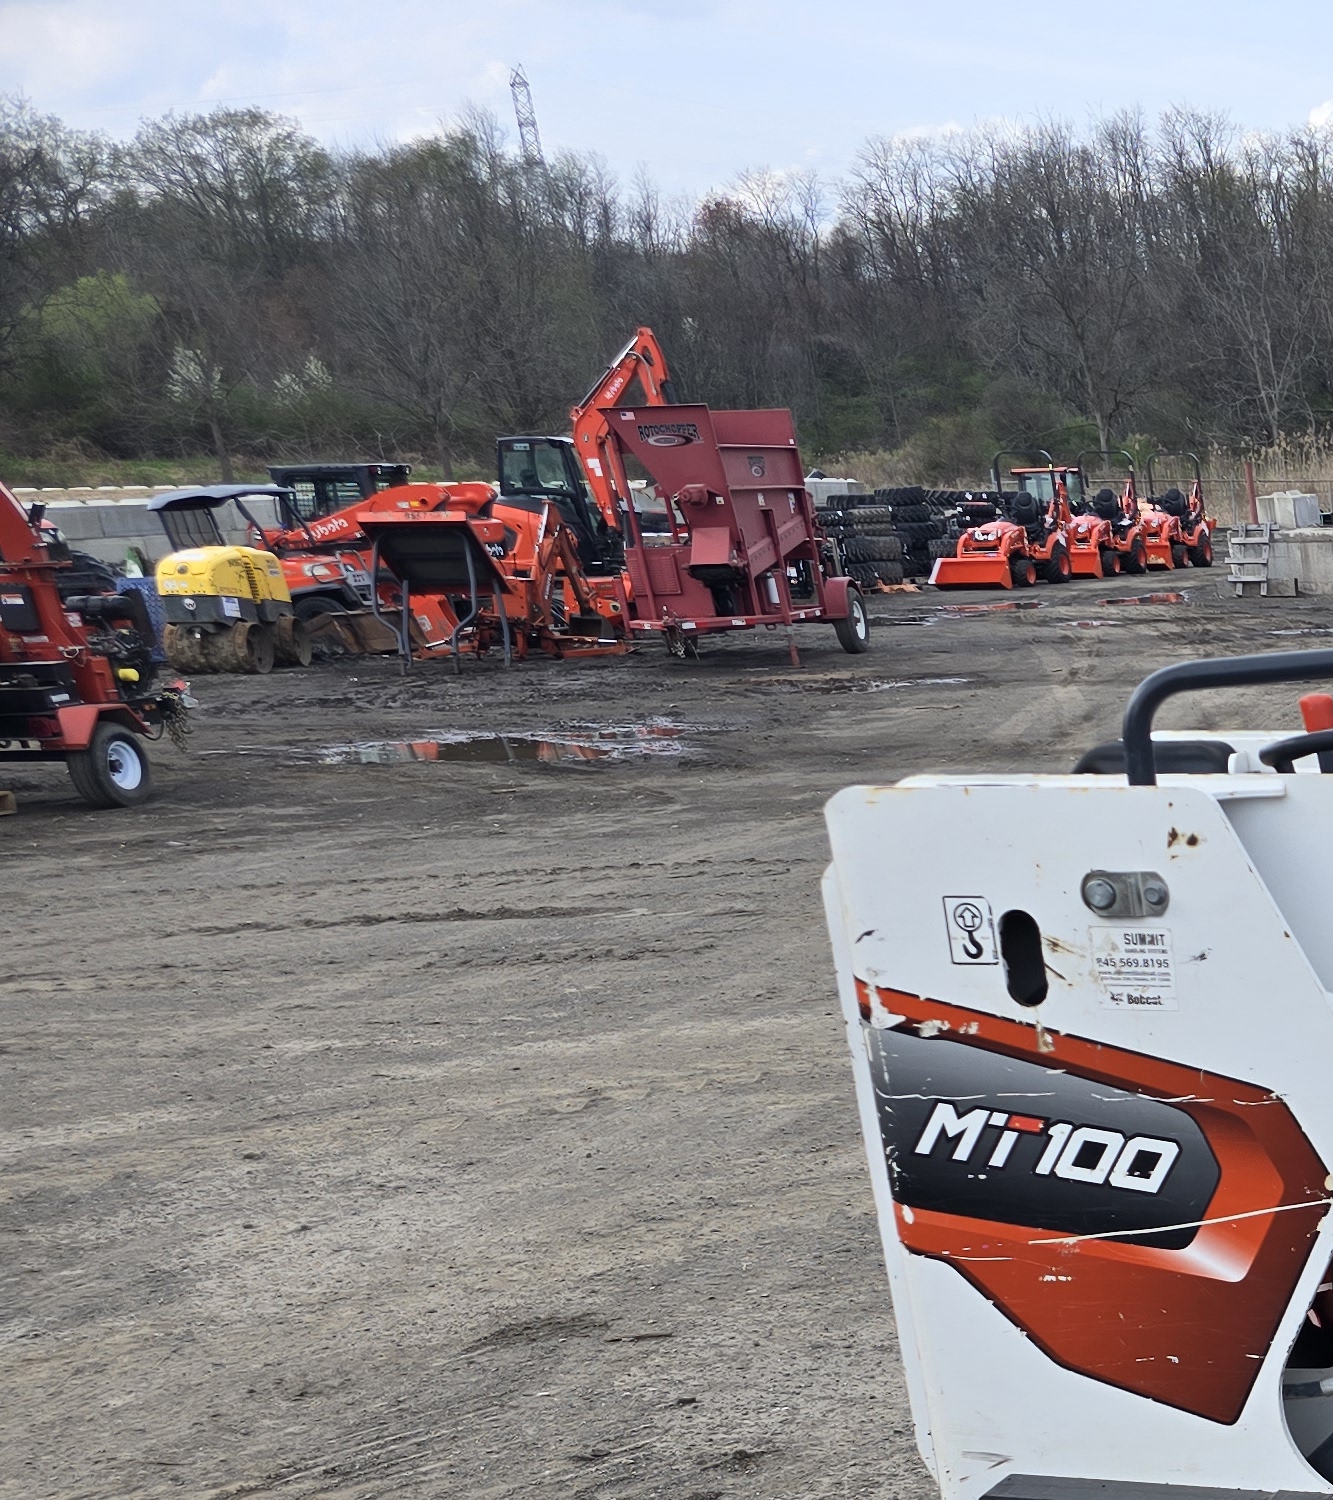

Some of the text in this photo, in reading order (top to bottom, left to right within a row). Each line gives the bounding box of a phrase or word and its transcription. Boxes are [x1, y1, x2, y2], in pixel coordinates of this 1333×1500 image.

[637, 423, 700, 442] ROTOCHOPPER
[1123, 932, 1165, 946] SUMMIT
[1126, 992, 1163, 1006] Bobcat
[914, 1102, 1181, 1194] MT100
